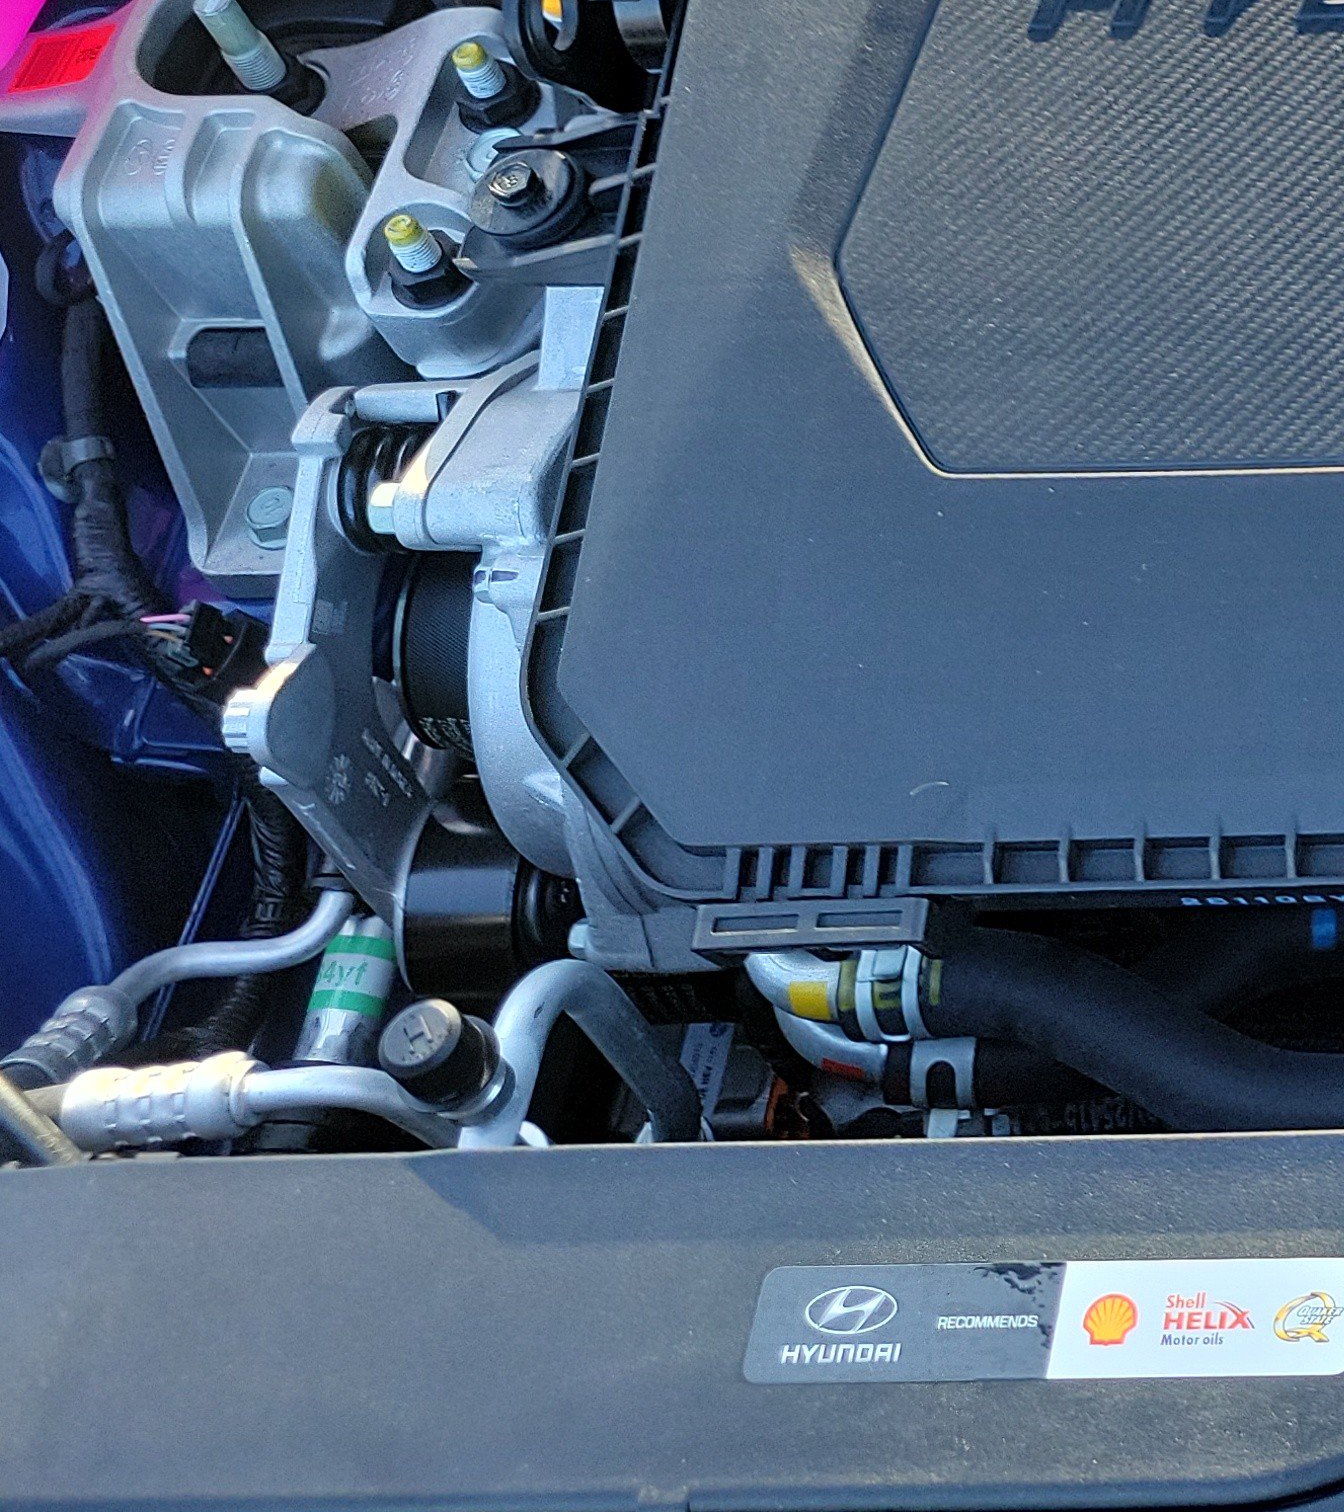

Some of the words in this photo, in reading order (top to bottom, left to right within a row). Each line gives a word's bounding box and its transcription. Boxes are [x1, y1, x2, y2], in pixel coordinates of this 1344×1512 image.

[1166, 1291, 1207, 1309] Shell
[1163, 1307, 1252, 1330] HELIX
[1297, 1305, 1344, 1317] QUAKER
[937, 1314, 1039, 1330] RECOMMENDS
[1300, 1314, 1335, 1325] STATE
[1160, 1334, 1199, 1346] Motor
[1202, 1332, 1224, 1345] oils
[780, 1342, 902, 1364] HYUNDAI
